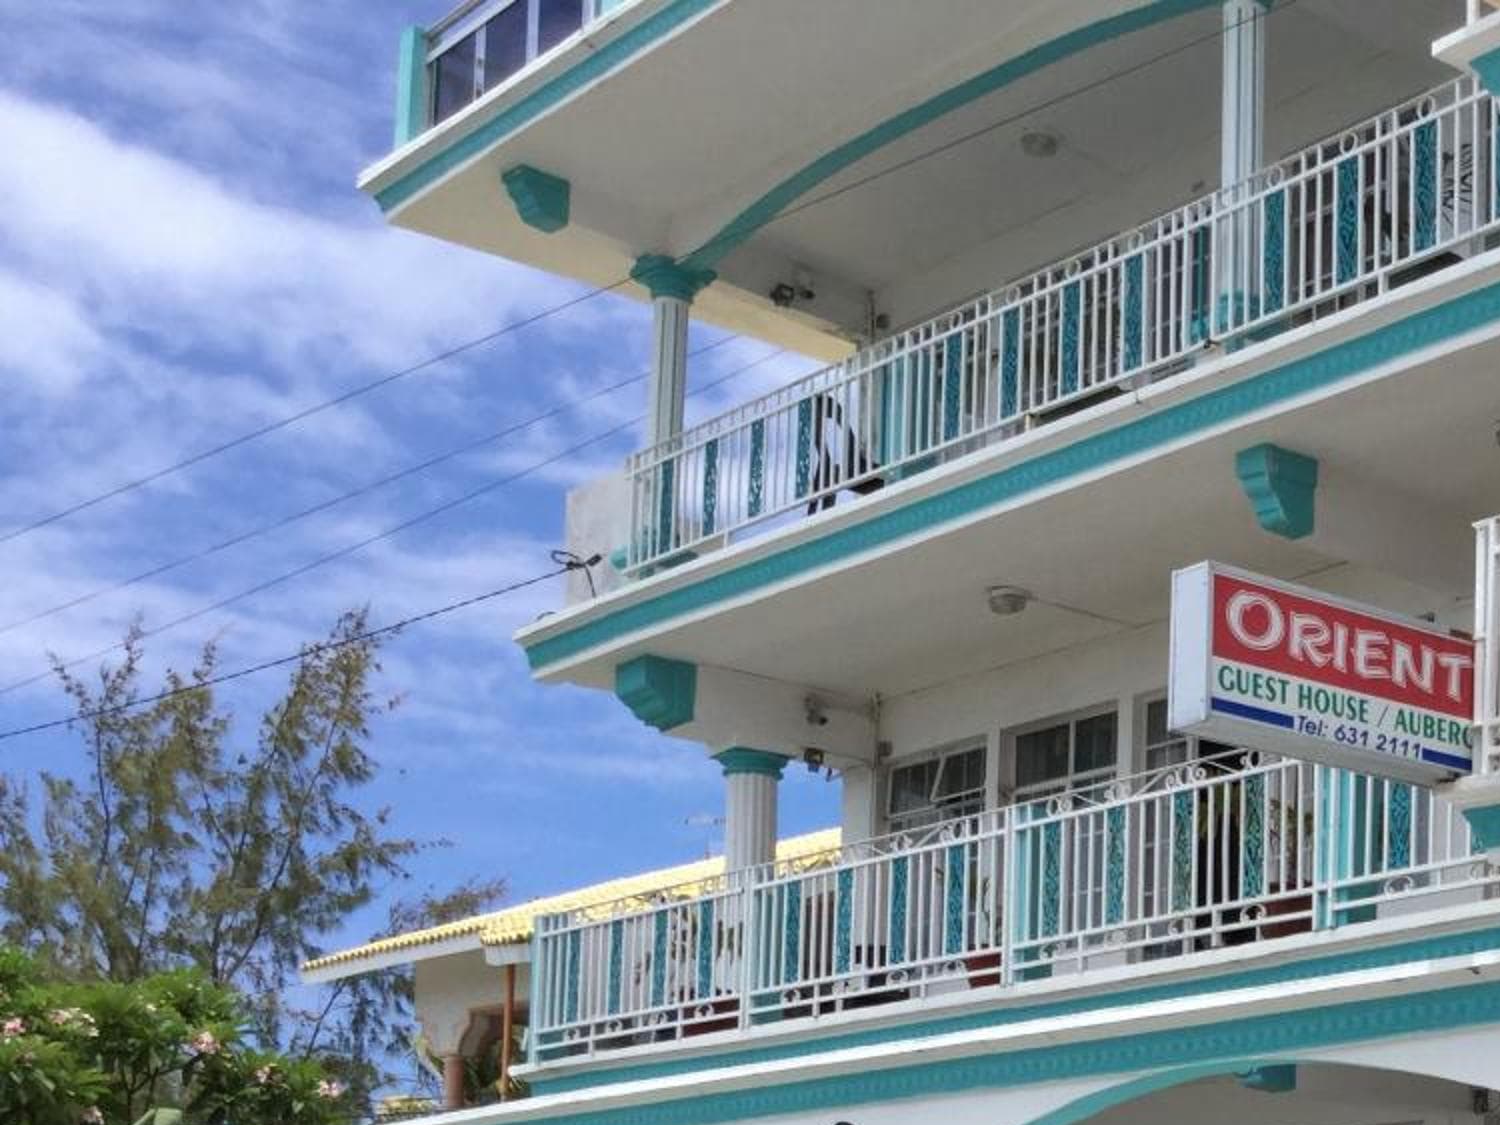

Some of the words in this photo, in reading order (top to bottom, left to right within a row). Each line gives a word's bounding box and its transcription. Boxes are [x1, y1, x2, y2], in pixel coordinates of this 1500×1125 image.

[1225, 589, 1473, 702] ORIENT
[1218, 665, 1290, 705] GUEST
[1298, 683, 1369, 723] HOUSE
[1394, 708, 1473, 750] AUBERG
[1298, 715, 1329, 737] Tel:
[1334, 724, 1370, 747] 631
[1375, 734, 1421, 759] 2111
